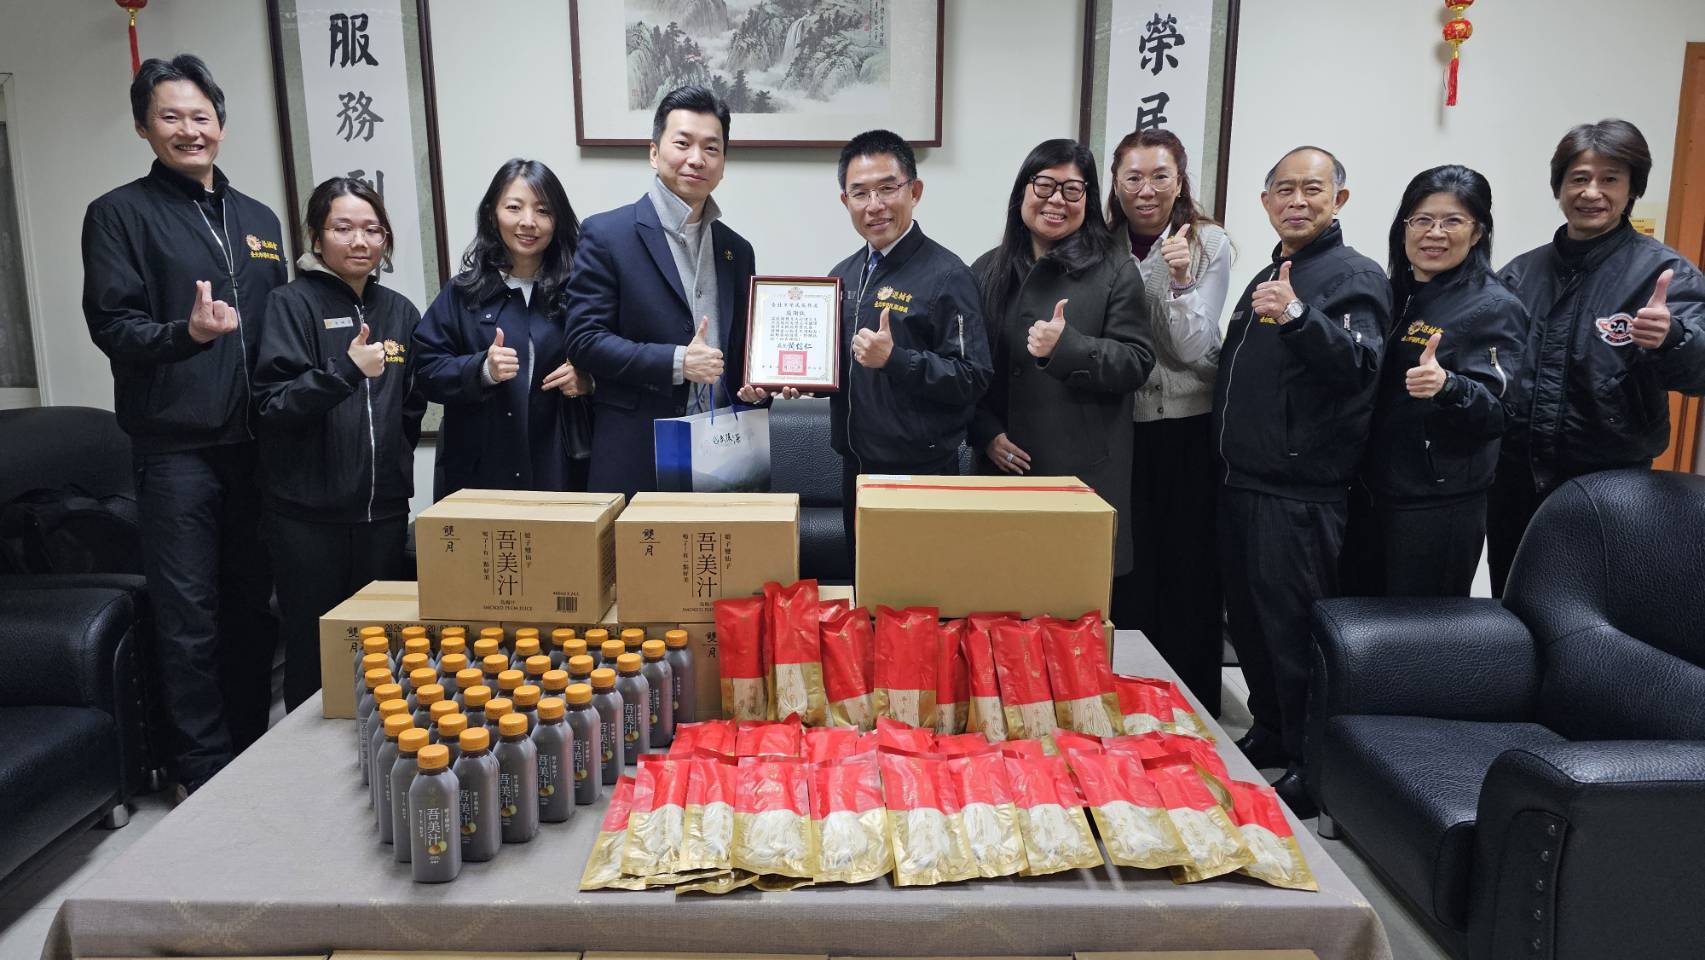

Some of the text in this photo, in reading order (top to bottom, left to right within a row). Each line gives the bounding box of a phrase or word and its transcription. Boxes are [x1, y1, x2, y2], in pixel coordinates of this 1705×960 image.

[1136, 13, 1186, 131] 榮民
[496, 529, 519, 597] 吾美汁
[696, 531, 718, 598] 吾美汁
[426, 807, 441, 846] 吾美汁
